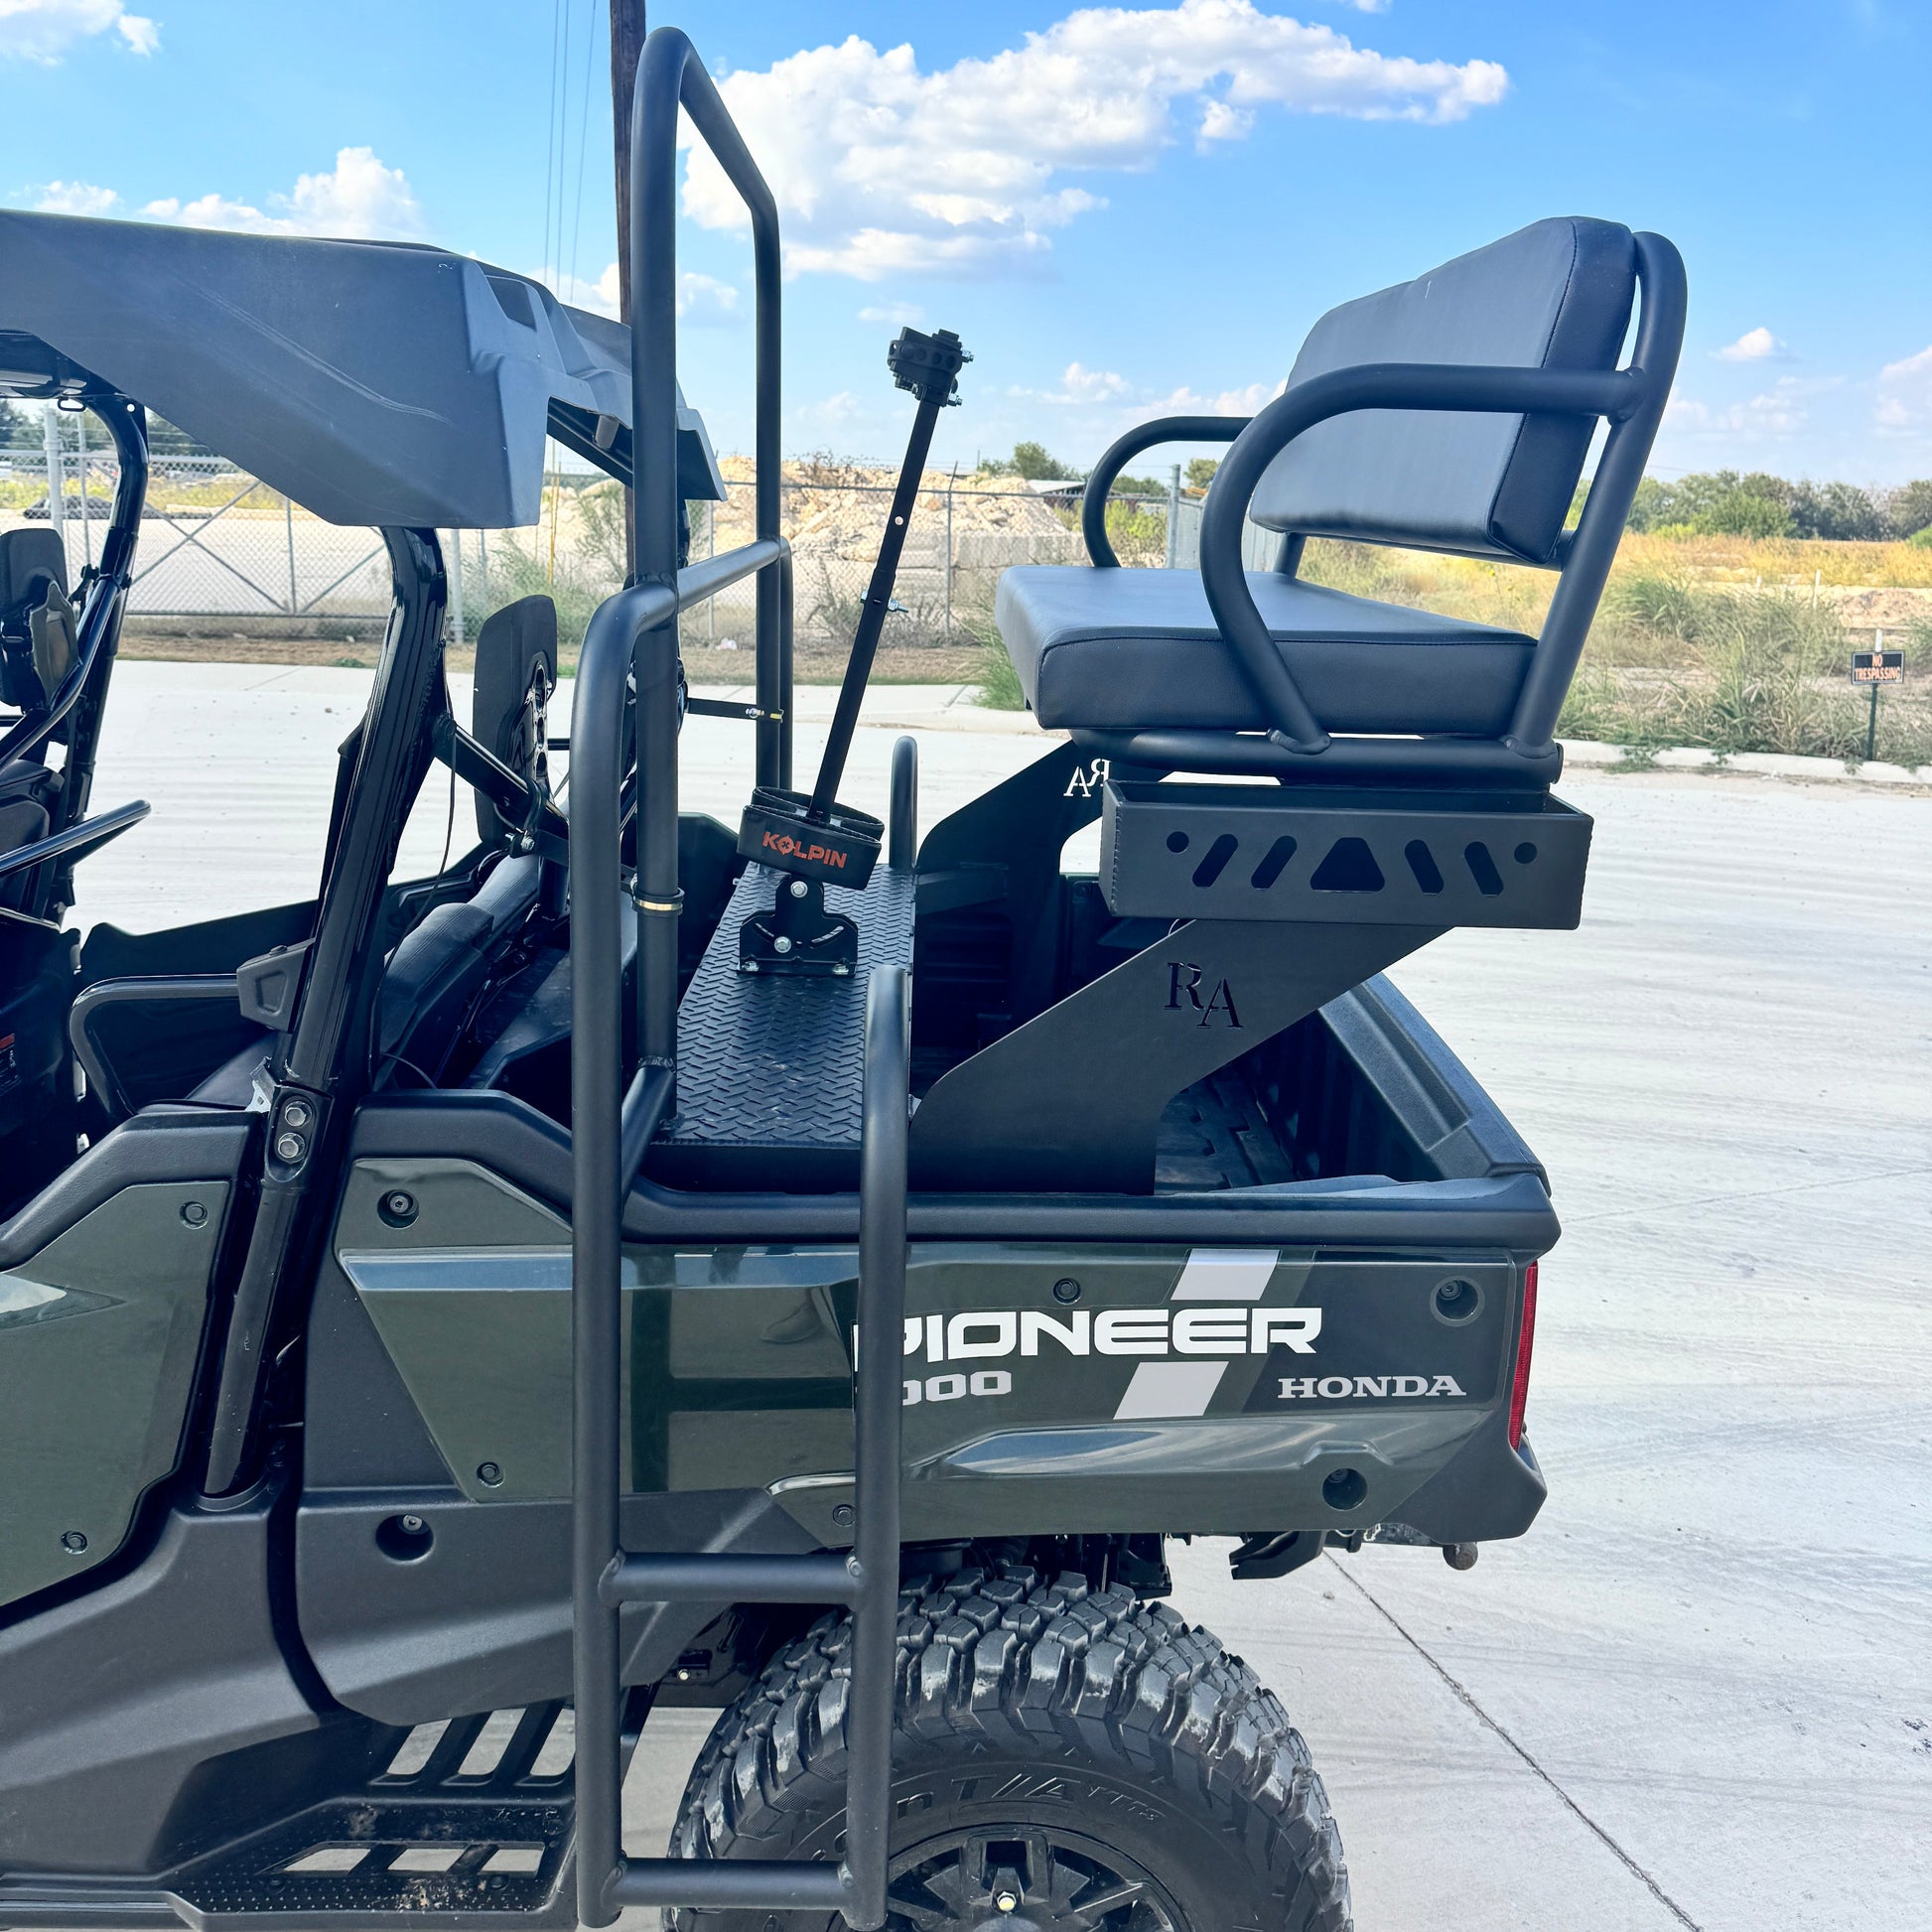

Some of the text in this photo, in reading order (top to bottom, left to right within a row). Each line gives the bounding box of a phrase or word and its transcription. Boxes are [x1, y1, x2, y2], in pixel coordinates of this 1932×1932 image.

[1855, 666, 1901, 681] TRESPASSING
[1871, 654, 1882, 667] NO
[761, 831, 847, 869] KOLPIN
[1165, 962, 1244, 1029] RA
[902, 1370, 1012, 1406] 000
[1277, 1375, 1466, 1399] HONDA
